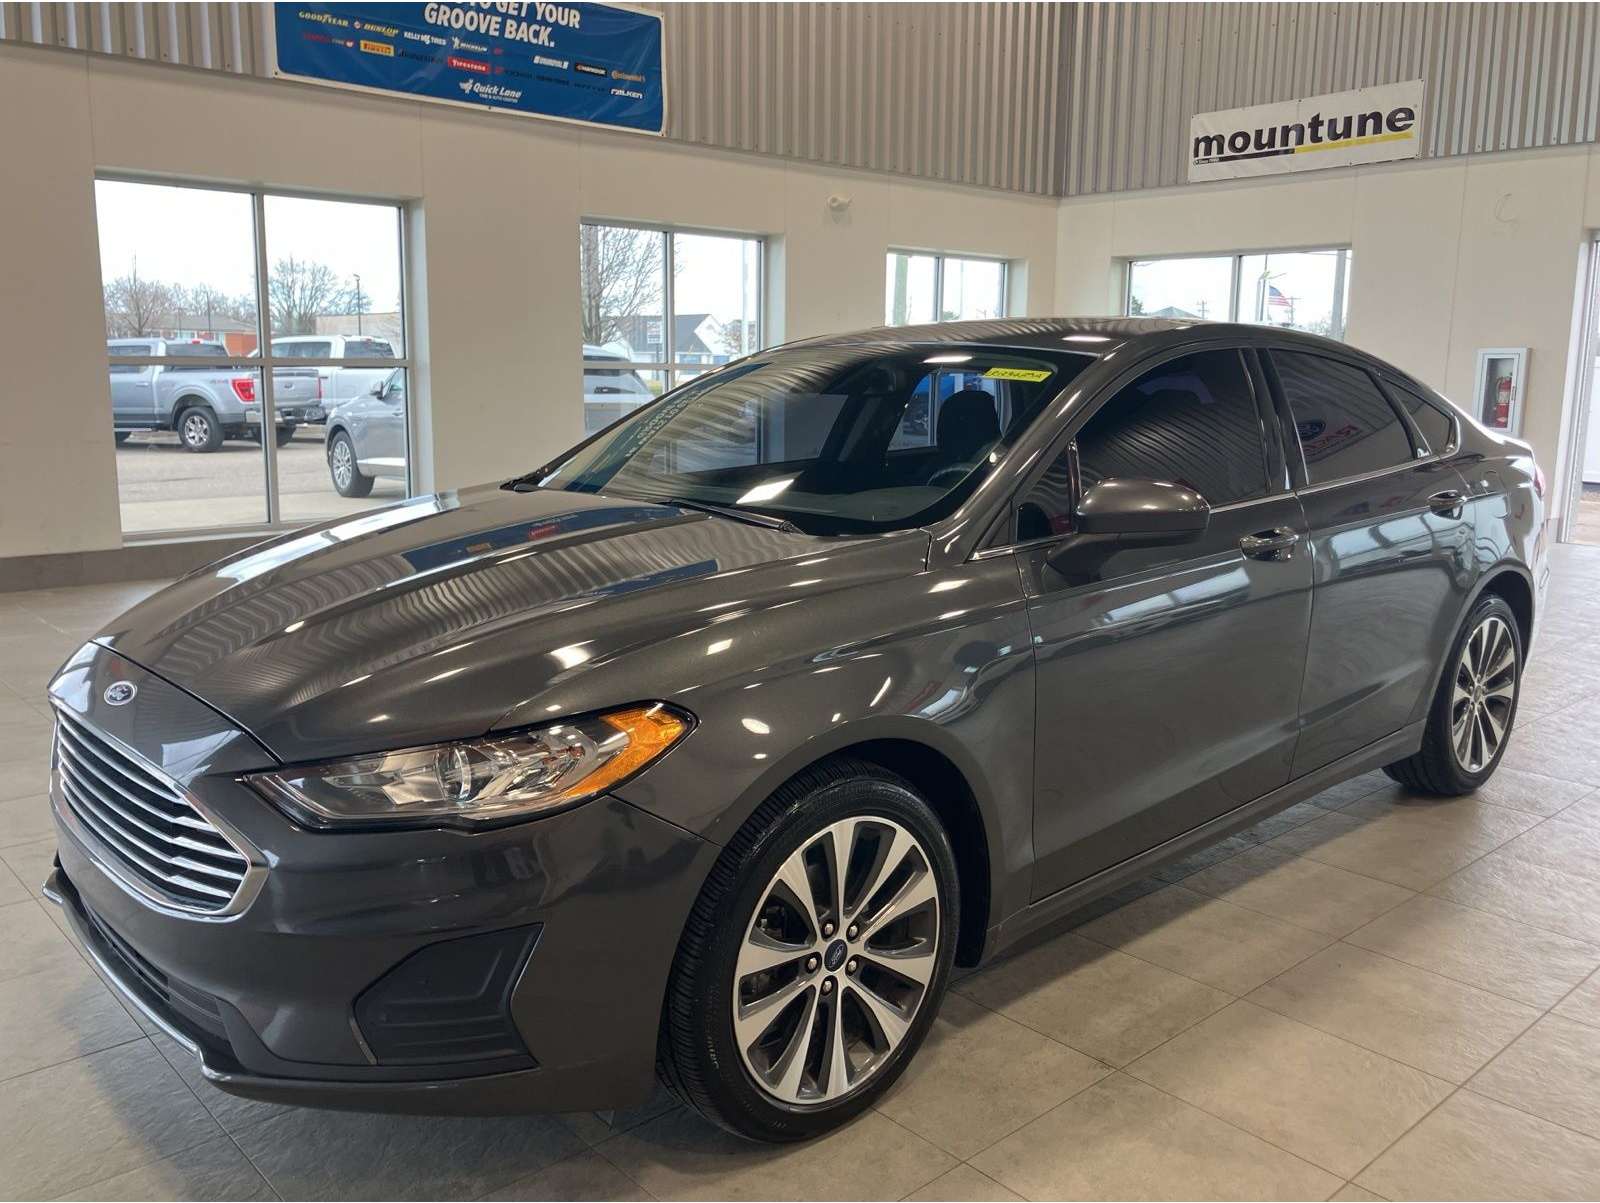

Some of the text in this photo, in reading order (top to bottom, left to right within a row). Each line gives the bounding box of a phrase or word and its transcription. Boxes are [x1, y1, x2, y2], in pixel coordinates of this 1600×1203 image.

[299, 11, 349, 27] GOODYEAR
[424, 3, 555, 48] GROOVE BACK.
[535, 1, 581, 28] YOUR
[452, 58, 487, 72] Firestone
[473, 82, 522, 99] Quick Lane
[1193, 106, 1416, 159] mountune
